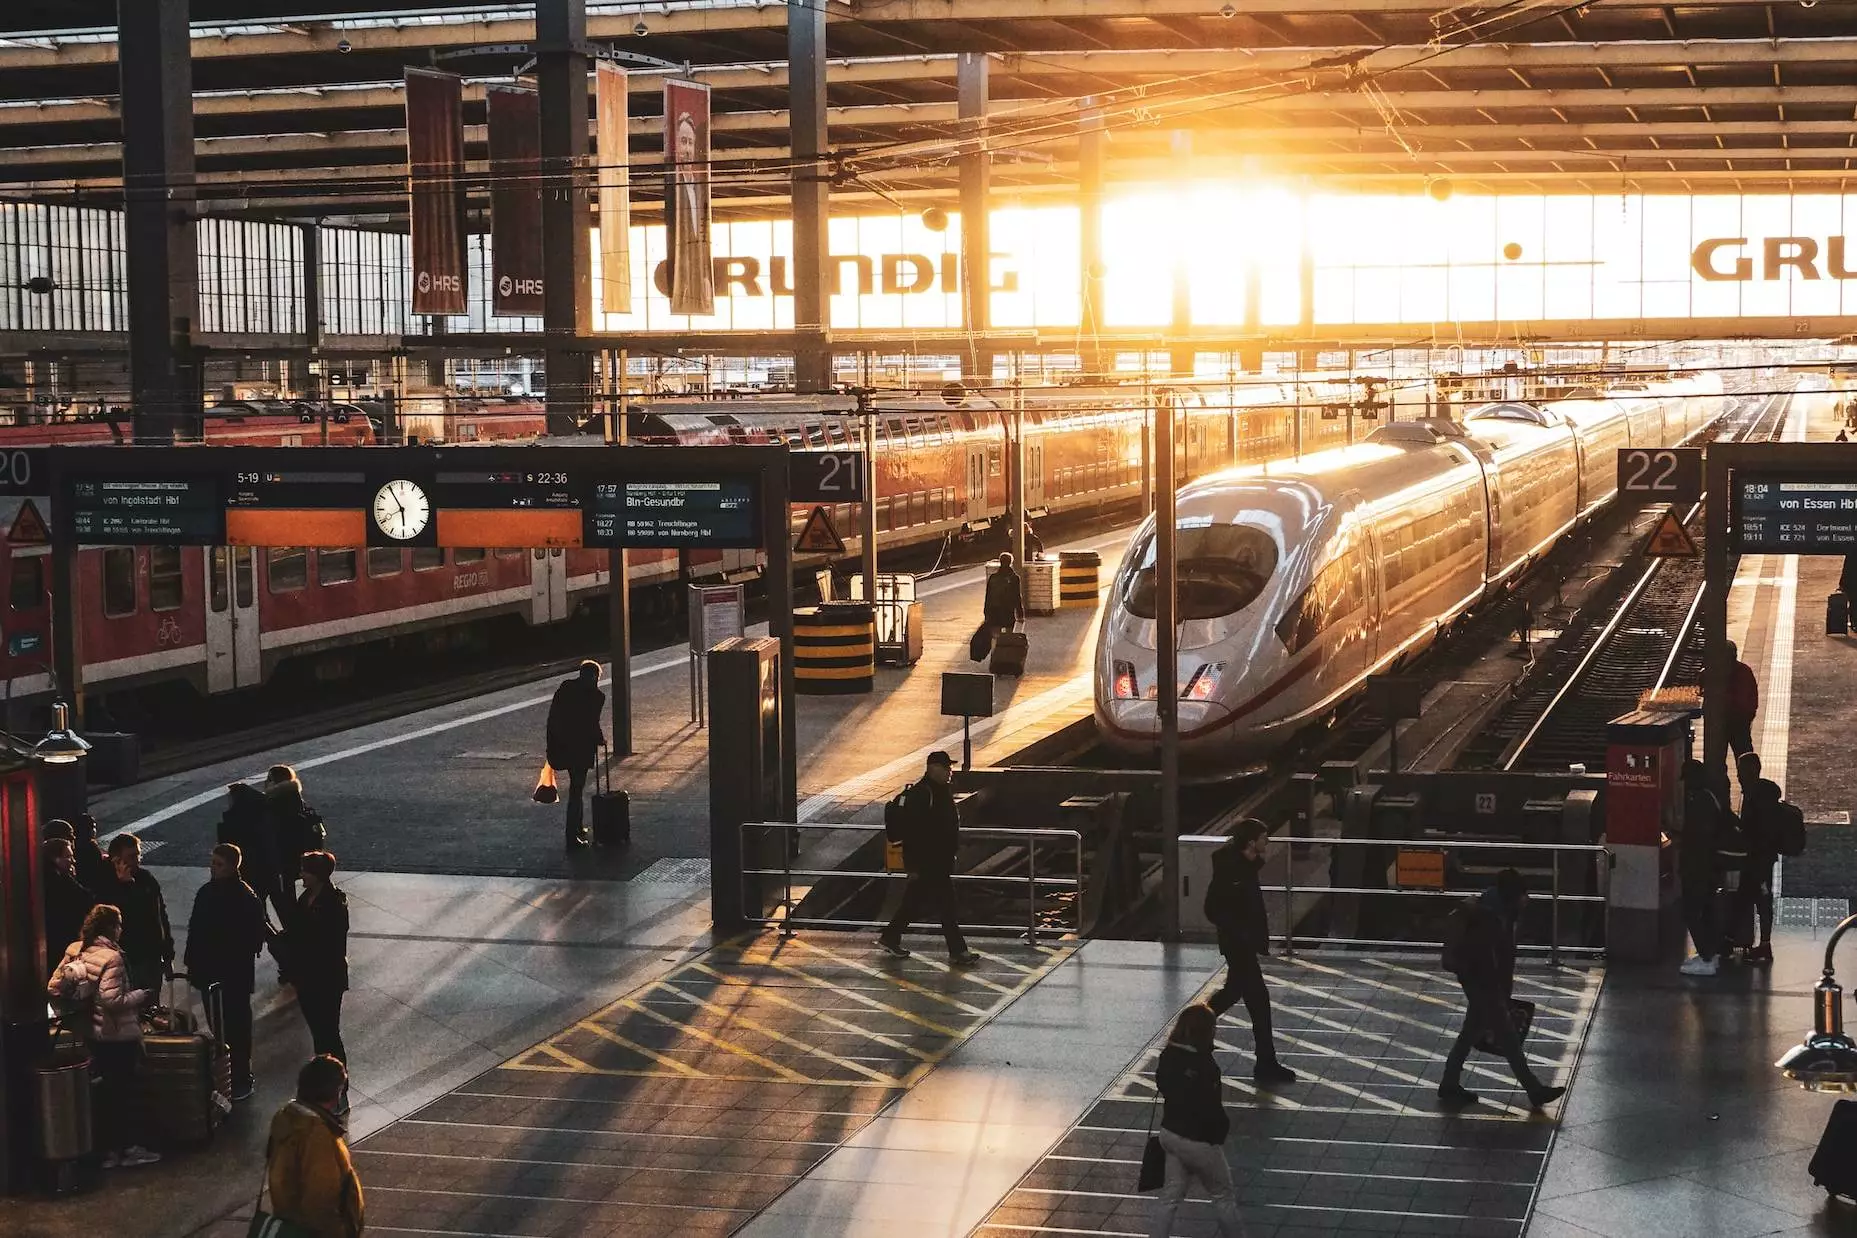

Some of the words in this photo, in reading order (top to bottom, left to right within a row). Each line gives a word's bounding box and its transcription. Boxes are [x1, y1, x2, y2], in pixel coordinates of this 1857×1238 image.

[433, 275, 460, 292] HRS
[515, 278, 544, 295] HRS
[819, 454, 858, 491] 21
[1626, 451, 1678, 490] 22
[237, 472, 259, 483] 5-19
[537, 472, 568, 484] 22-36
[596, 484, 617, 493] 17:57
[1744, 484, 1769, 493] 18:04
[103, 496, 118, 505] von
[121, 495, 161, 507] Ingolstadt
[165, 495, 180, 505] Hbf
[626, 496, 686, 507] Bln-Gesundbr
[1779, 500, 1800, 509] von
[1803, 498, 1836, 509] Essen
[1816, 524, 1852, 532] Dortmund
[1832, 533, 1855, 541] Essen
[453, 572, 478, 590] REGIO
[1608, 771, 1652, 782] Fahrkarten
[1479, 796, 1492, 809] 22
